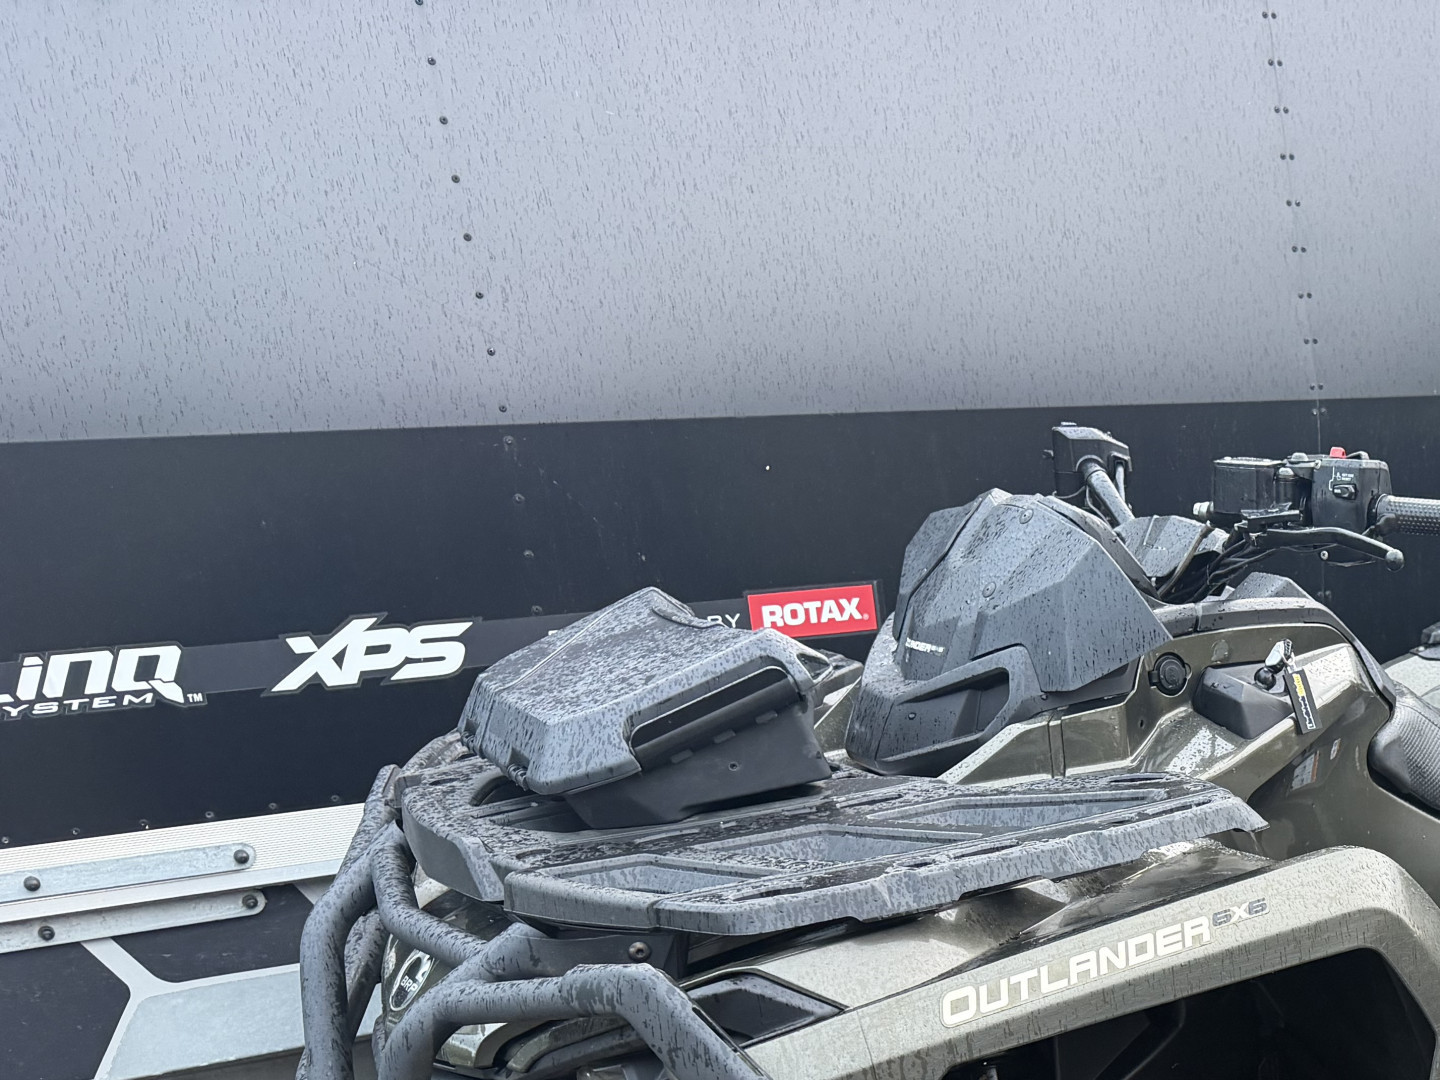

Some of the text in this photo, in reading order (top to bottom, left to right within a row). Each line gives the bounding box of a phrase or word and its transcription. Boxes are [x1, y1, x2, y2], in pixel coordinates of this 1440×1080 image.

[761, 597, 863, 628] ROTAX
[271, 617, 474, 692] XPS
[400, 975, 419, 992] BRP
[942, 915, 1211, 1026] OUTLANDER
